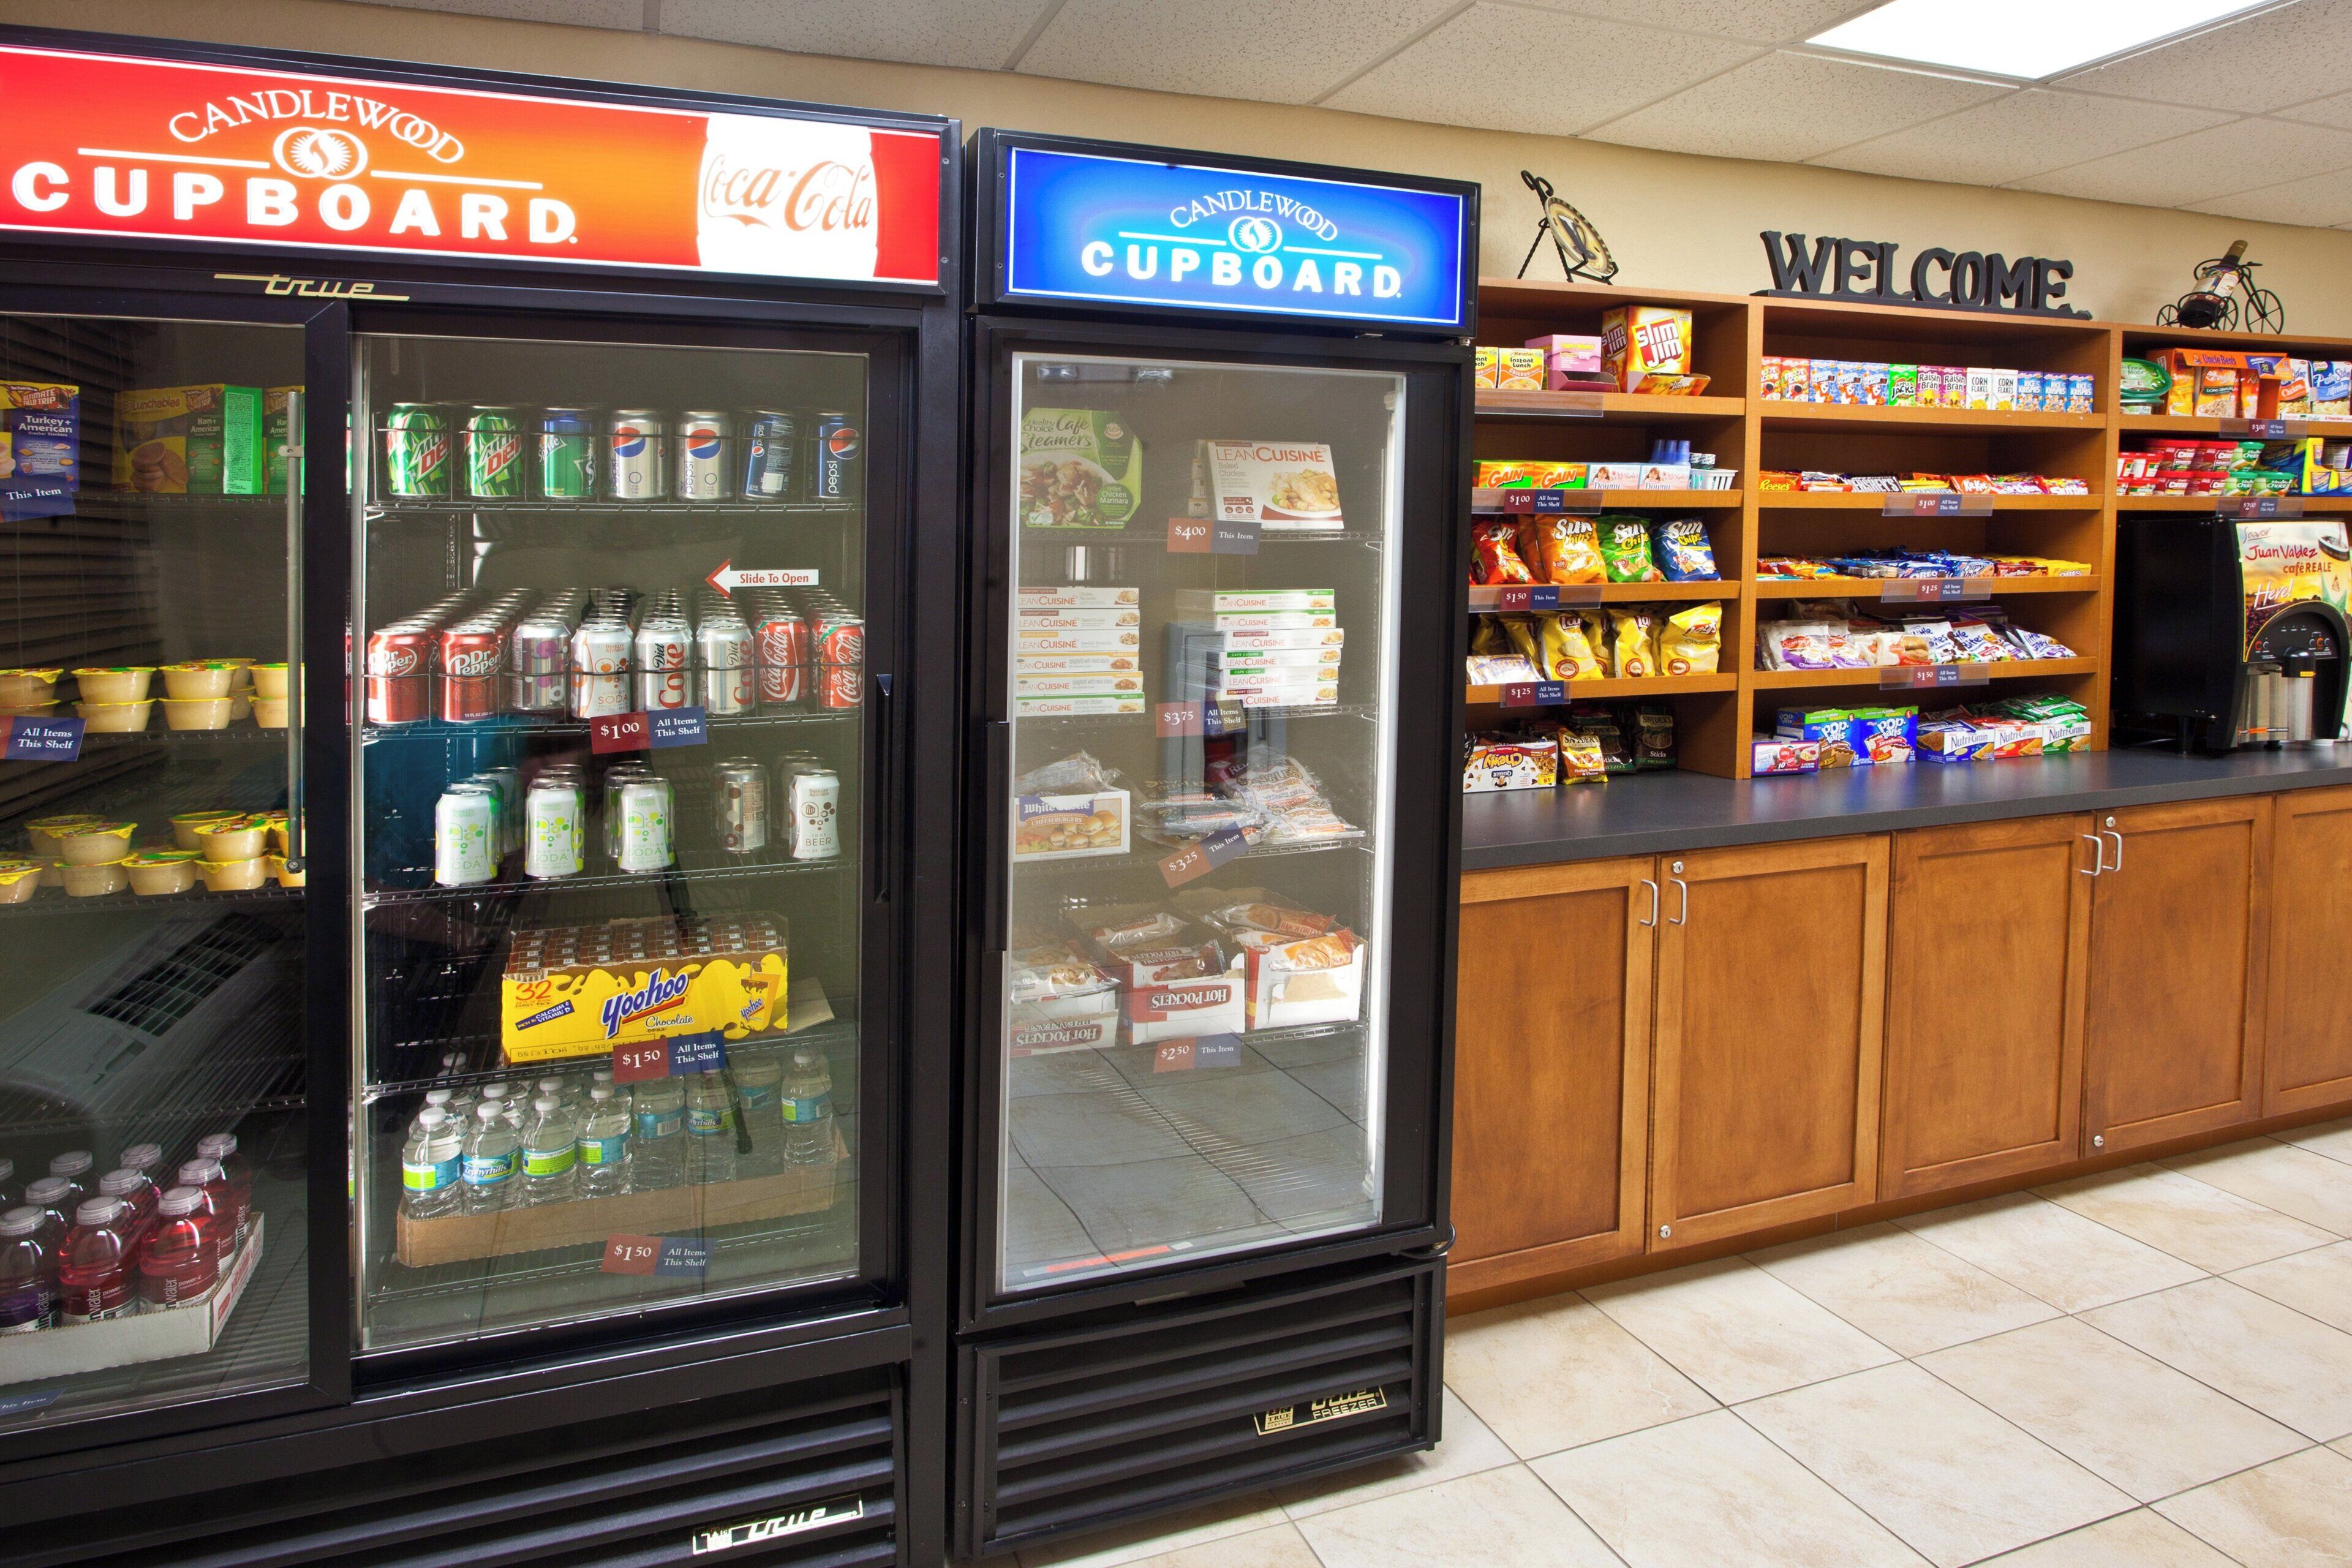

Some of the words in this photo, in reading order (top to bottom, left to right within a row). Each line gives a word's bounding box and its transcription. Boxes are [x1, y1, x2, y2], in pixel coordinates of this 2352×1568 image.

[169, 89, 465, 164] CANDLEWOOD
[704, 154, 872, 231] Coca-Cola
[1170, 190, 1337, 241] CANDLEWOOD
[1760, 231, 2073, 311] WELCOME
[2202, 354, 2220, 364] Uncle
[1918, 373, 1942, 383] Raisin
[1944, 375, 1966, 385] Raisin
[1972, 376, 1988, 386] CORN
[1998, 377, 2014, 386] CORN
[1891, 385, 1915, 398] JACKS
[1921, 382, 1940, 391] Bran
[1947, 383, 1964, 392] Bran
[1997, 385, 2014, 394] FLAKES
[2018, 386, 2041, 394] KRISPIES
[2045, 386, 2067, 396] KRISPIES
[2282, 383, 2304, 397] Chicken
[2326, 382, 2349, 396] Alfredo
[23, 388, 56, 401] ULTIMATE
[132, 398, 180, 411] Lunchables
[18, 423, 72, 433] American
[1023, 424, 1054, 433] Choice
[1028, 418, 1055, 428] Healthy
[1020, 432, 1091, 454] Steamers
[685, 460, 696, 494] pepsi
[827, 460, 840, 494] pepsi
[1487, 469, 1525, 489] GAIN
[1540, 469, 1579, 489] GAIN
[6, 491, 32, 501] This
[36, 487, 61, 498] Item
[1219, 531, 1236, 540] This
[1237, 532, 1254, 540] Item
[1555, 518, 1593, 540] Sun
[1668, 521, 1703, 539] Sun
[2243, 526, 2271, 544] Savor
[1562, 531, 1593, 546] Chips
[1621, 532, 1649, 550] Chips
[1678, 533, 1703, 546] Chips
[2245, 545, 2280, 560] Juan
[2280, 545, 2318, 560] Valdez
[740, 573, 765, 584] Slide
[767, 573, 780, 584] To
[782, 572, 809, 585] Open
[2253, 578, 2294, 608] Here!
[1962, 635, 1983, 649] Bites
[470, 650, 491, 663] Dr
[653, 643, 665, 669] Diet
[727, 641, 739, 666] Diet
[452, 654, 500, 676] Pepper
[761, 629, 788, 699] Coca-Cola
[659, 641, 685, 709] Coke
[734, 641, 754, 706] Coke
[598, 694, 628, 705] SODA
[657, 718, 671, 727] All
[673, 717, 697, 726] Items
[23, 728, 40, 737] All
[43, 728, 72, 737] Items
[655, 728, 676, 737] This
[678, 726, 700, 736] Shelf
[18, 739, 42, 748] This
[45, 739, 73, 750] Shelf
[1483, 752, 1524, 769] Chewy
[1024, 803, 1055, 814] White
[1031, 816, 1082, 826] CHEESEBURGERS
[805, 837, 832, 846] BEER
[1209, 842, 1224, 853] This
[1224, 832, 1240, 845] Item
[1281, 921, 1294, 930] HAM
[516, 981, 552, 1001] 32
[1205, 989, 1228, 1001] HOT
[1152, 993, 1203, 1009] POCKETS
[536, 1004, 565, 1019] CALCIUM
[538, 1010, 564, 1023] VITAMIN
[646, 1014, 694, 1028] Chocolate
[1016, 1030, 1073, 1047] POCKETS
[1075, 1028, 1097, 1039] HOT
[677, 1044, 691, 1053] All
[693, 1042, 717, 1052] Items
[676, 1054, 696, 1064] This
[698, 1050, 719, 1061] Shelf
[465, 1163, 508, 1177] Zephyrhills
[668, 1248, 681, 1257] All
[684, 1247, 706, 1257] Items
[664, 1257, 682, 1267] This
[685, 1257, 707, 1268] Shelf
[1313, 1398, 1378, 1420] FREEZER
[1268, 1413, 1291, 1422] TRUE
